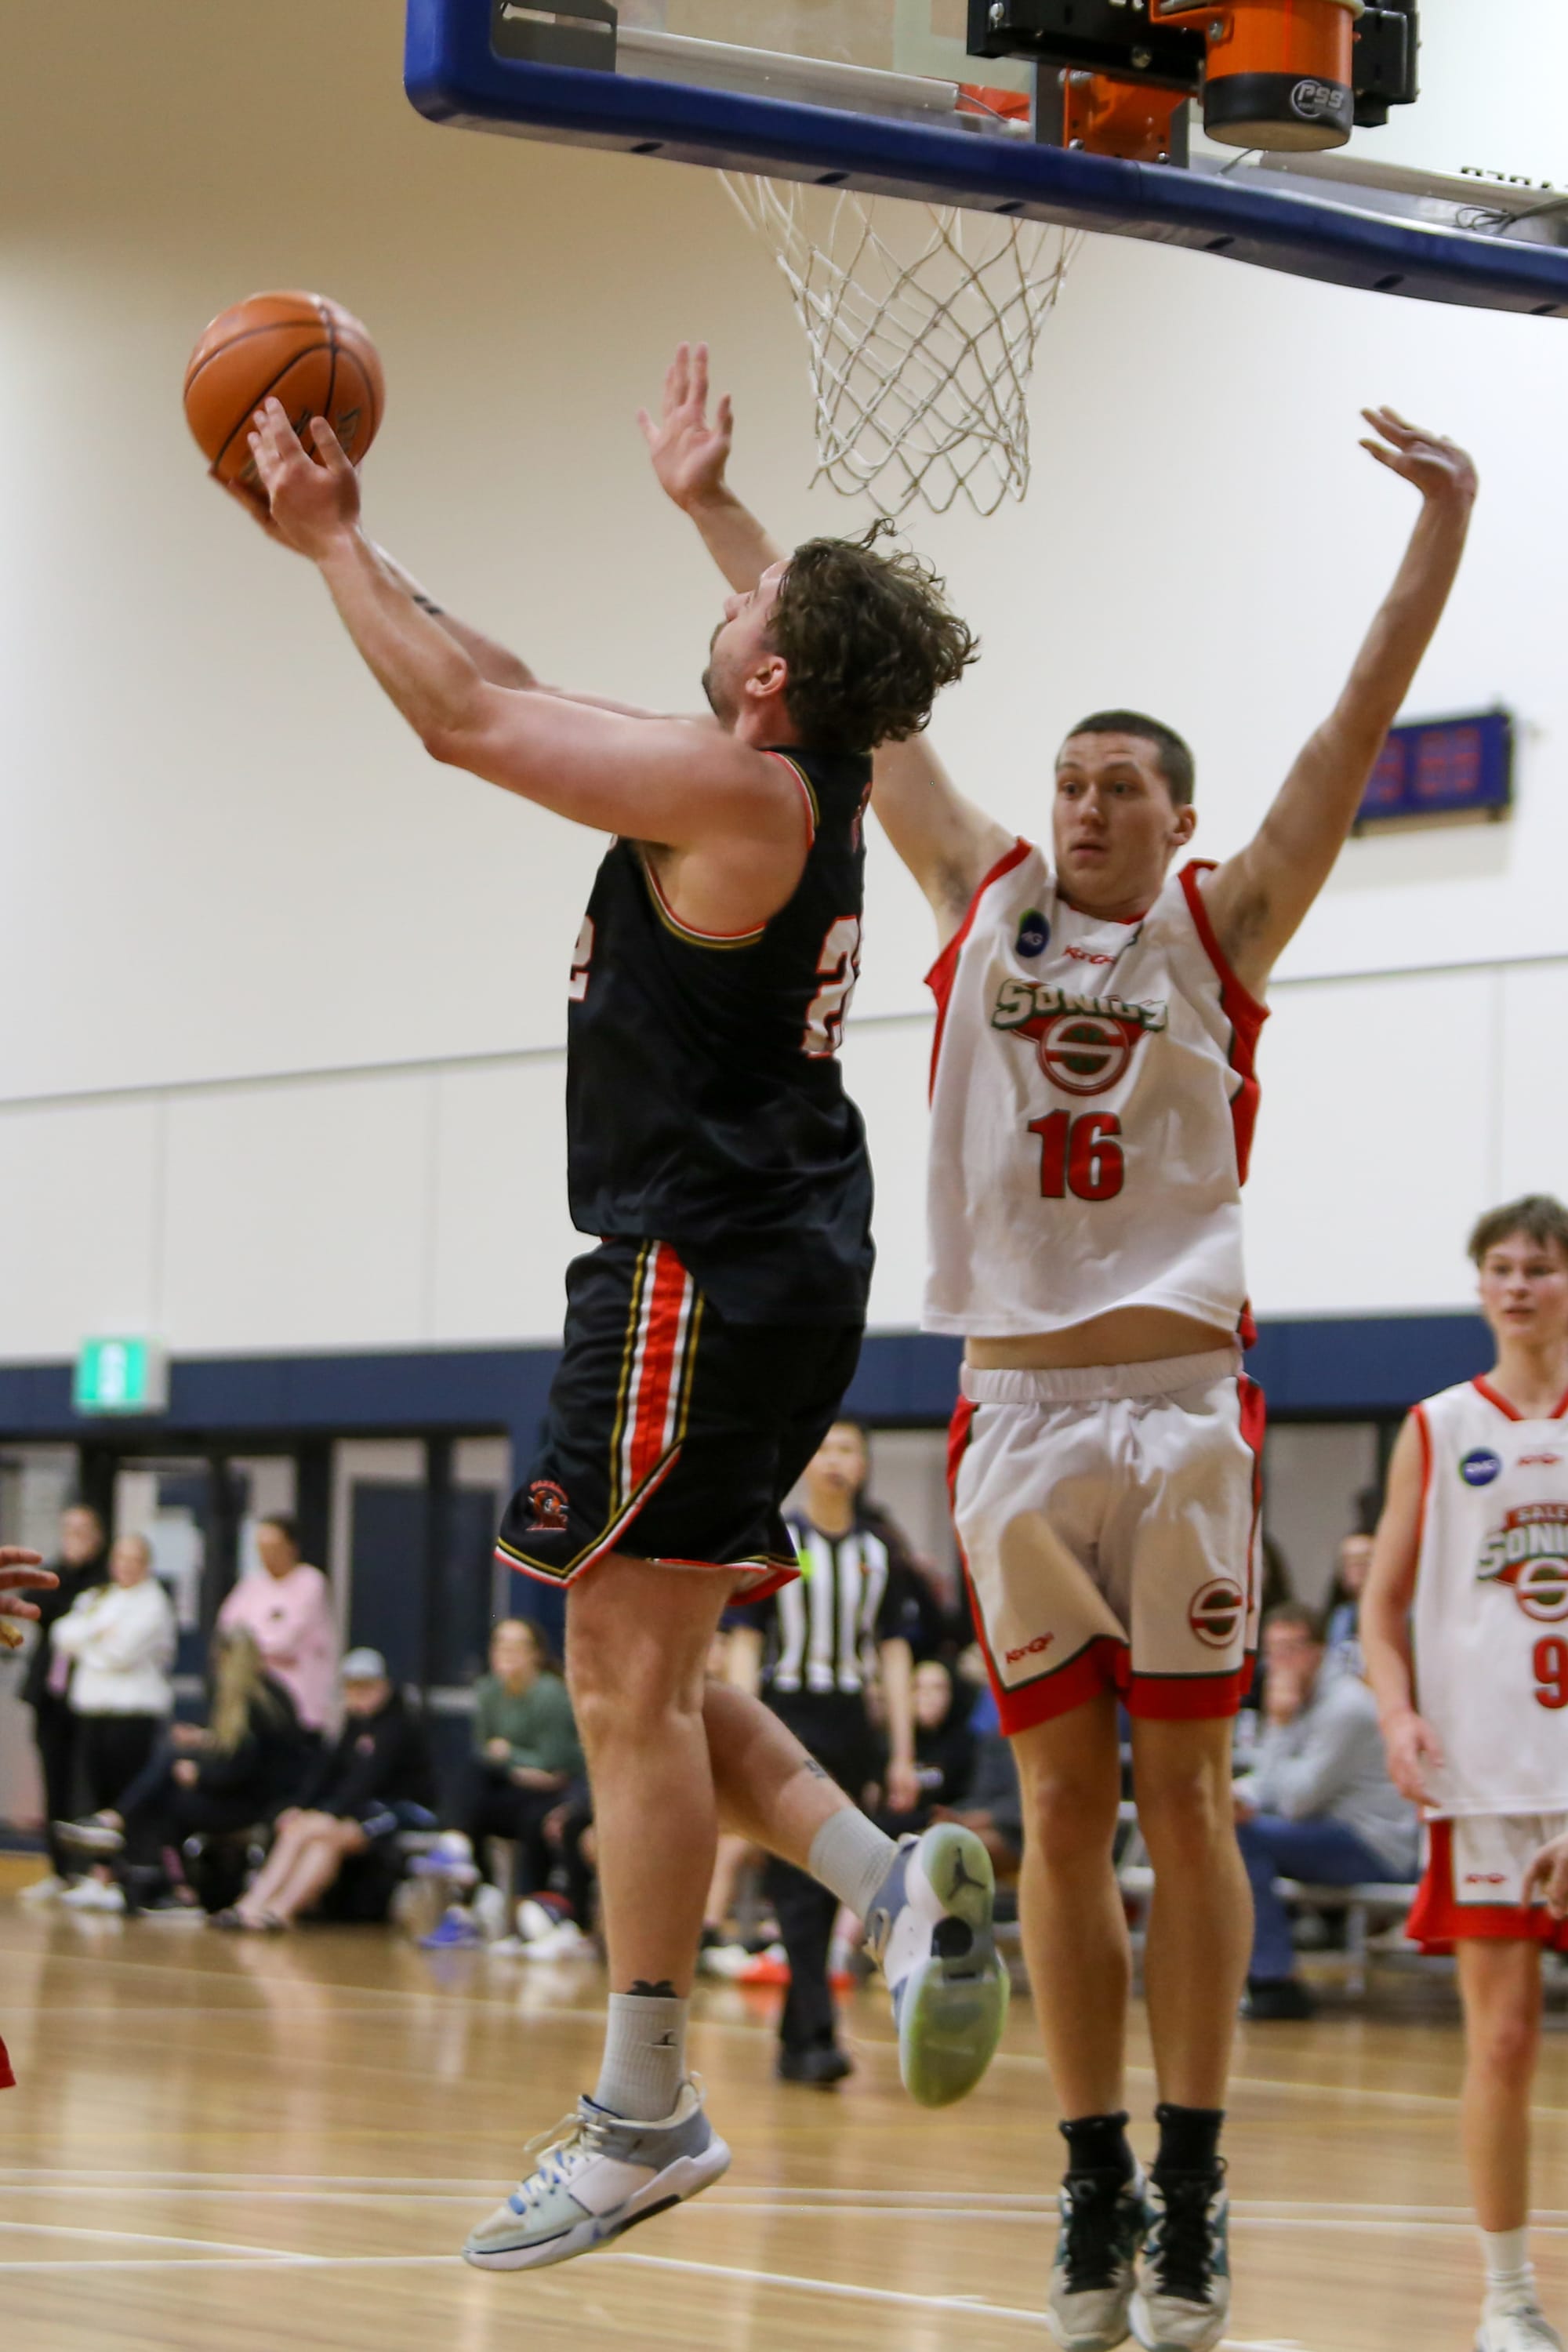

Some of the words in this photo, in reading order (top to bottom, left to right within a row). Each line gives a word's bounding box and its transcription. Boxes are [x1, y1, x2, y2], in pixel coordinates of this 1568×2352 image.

[1027, 1109, 1124, 1201] 16
[1477, 1523, 1568, 1581] SONI
[1533, 1634, 1568, 1709] 9
